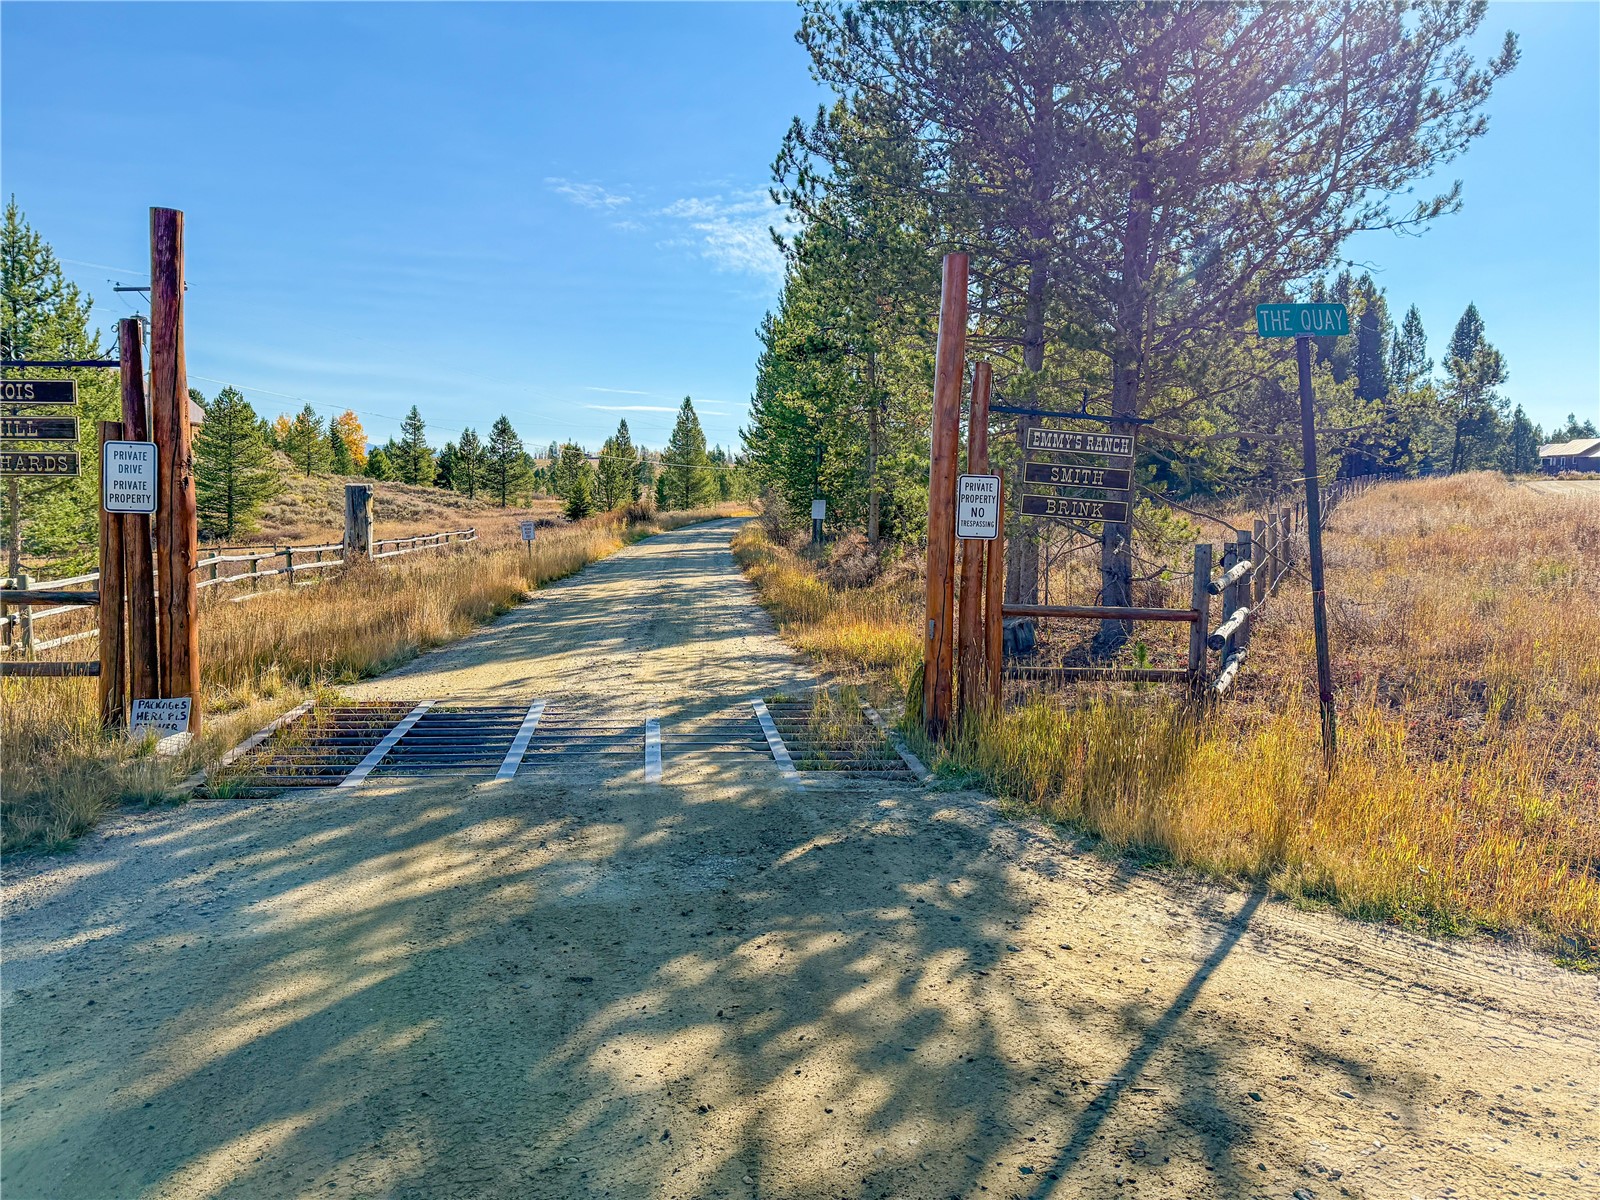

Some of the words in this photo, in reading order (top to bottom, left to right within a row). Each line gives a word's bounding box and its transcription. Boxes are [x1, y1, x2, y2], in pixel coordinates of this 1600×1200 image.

[1260, 310, 1293, 331] THE
[1301, 309, 1342, 331] QUAY
[1032, 431, 1082, 449] EMMY'S
[1086, 436, 1130, 453] RANCH
[113, 450, 148, 461] PRIVATE
[118, 464, 143, 474] DRIVE
[1050, 467, 1104, 485] SMITH
[113, 480, 148, 491] PRIVATE
[964, 482, 994, 492] PRIVATE
[109, 493, 152, 504] PROPERTY
[961, 494, 997, 504] PROPERTY
[970, 507, 985, 518] NO
[1045, 499, 1104, 518] BRINK
[960, 520, 995, 528] TRESPASSING
